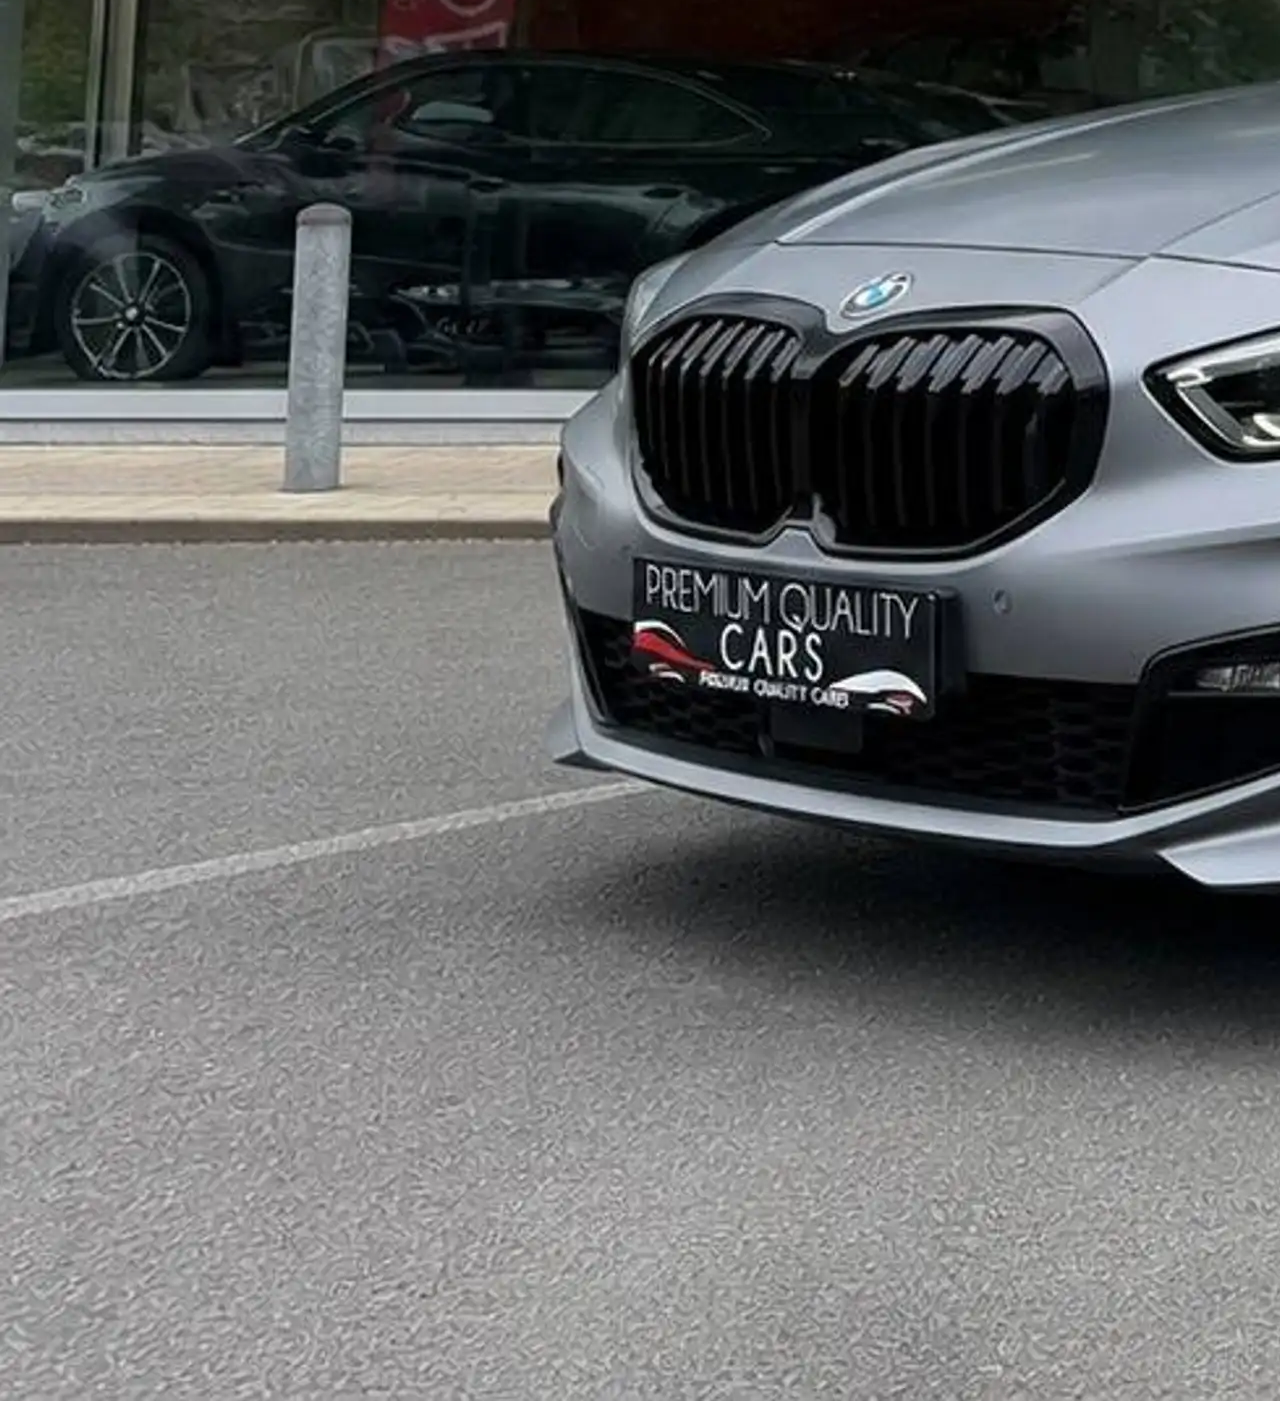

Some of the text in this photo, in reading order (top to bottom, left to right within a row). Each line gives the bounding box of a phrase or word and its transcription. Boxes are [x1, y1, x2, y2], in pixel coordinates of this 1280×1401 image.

[645, 564, 920, 640] PREMIUM QUALITY
[720, 623, 824, 683] CARS
